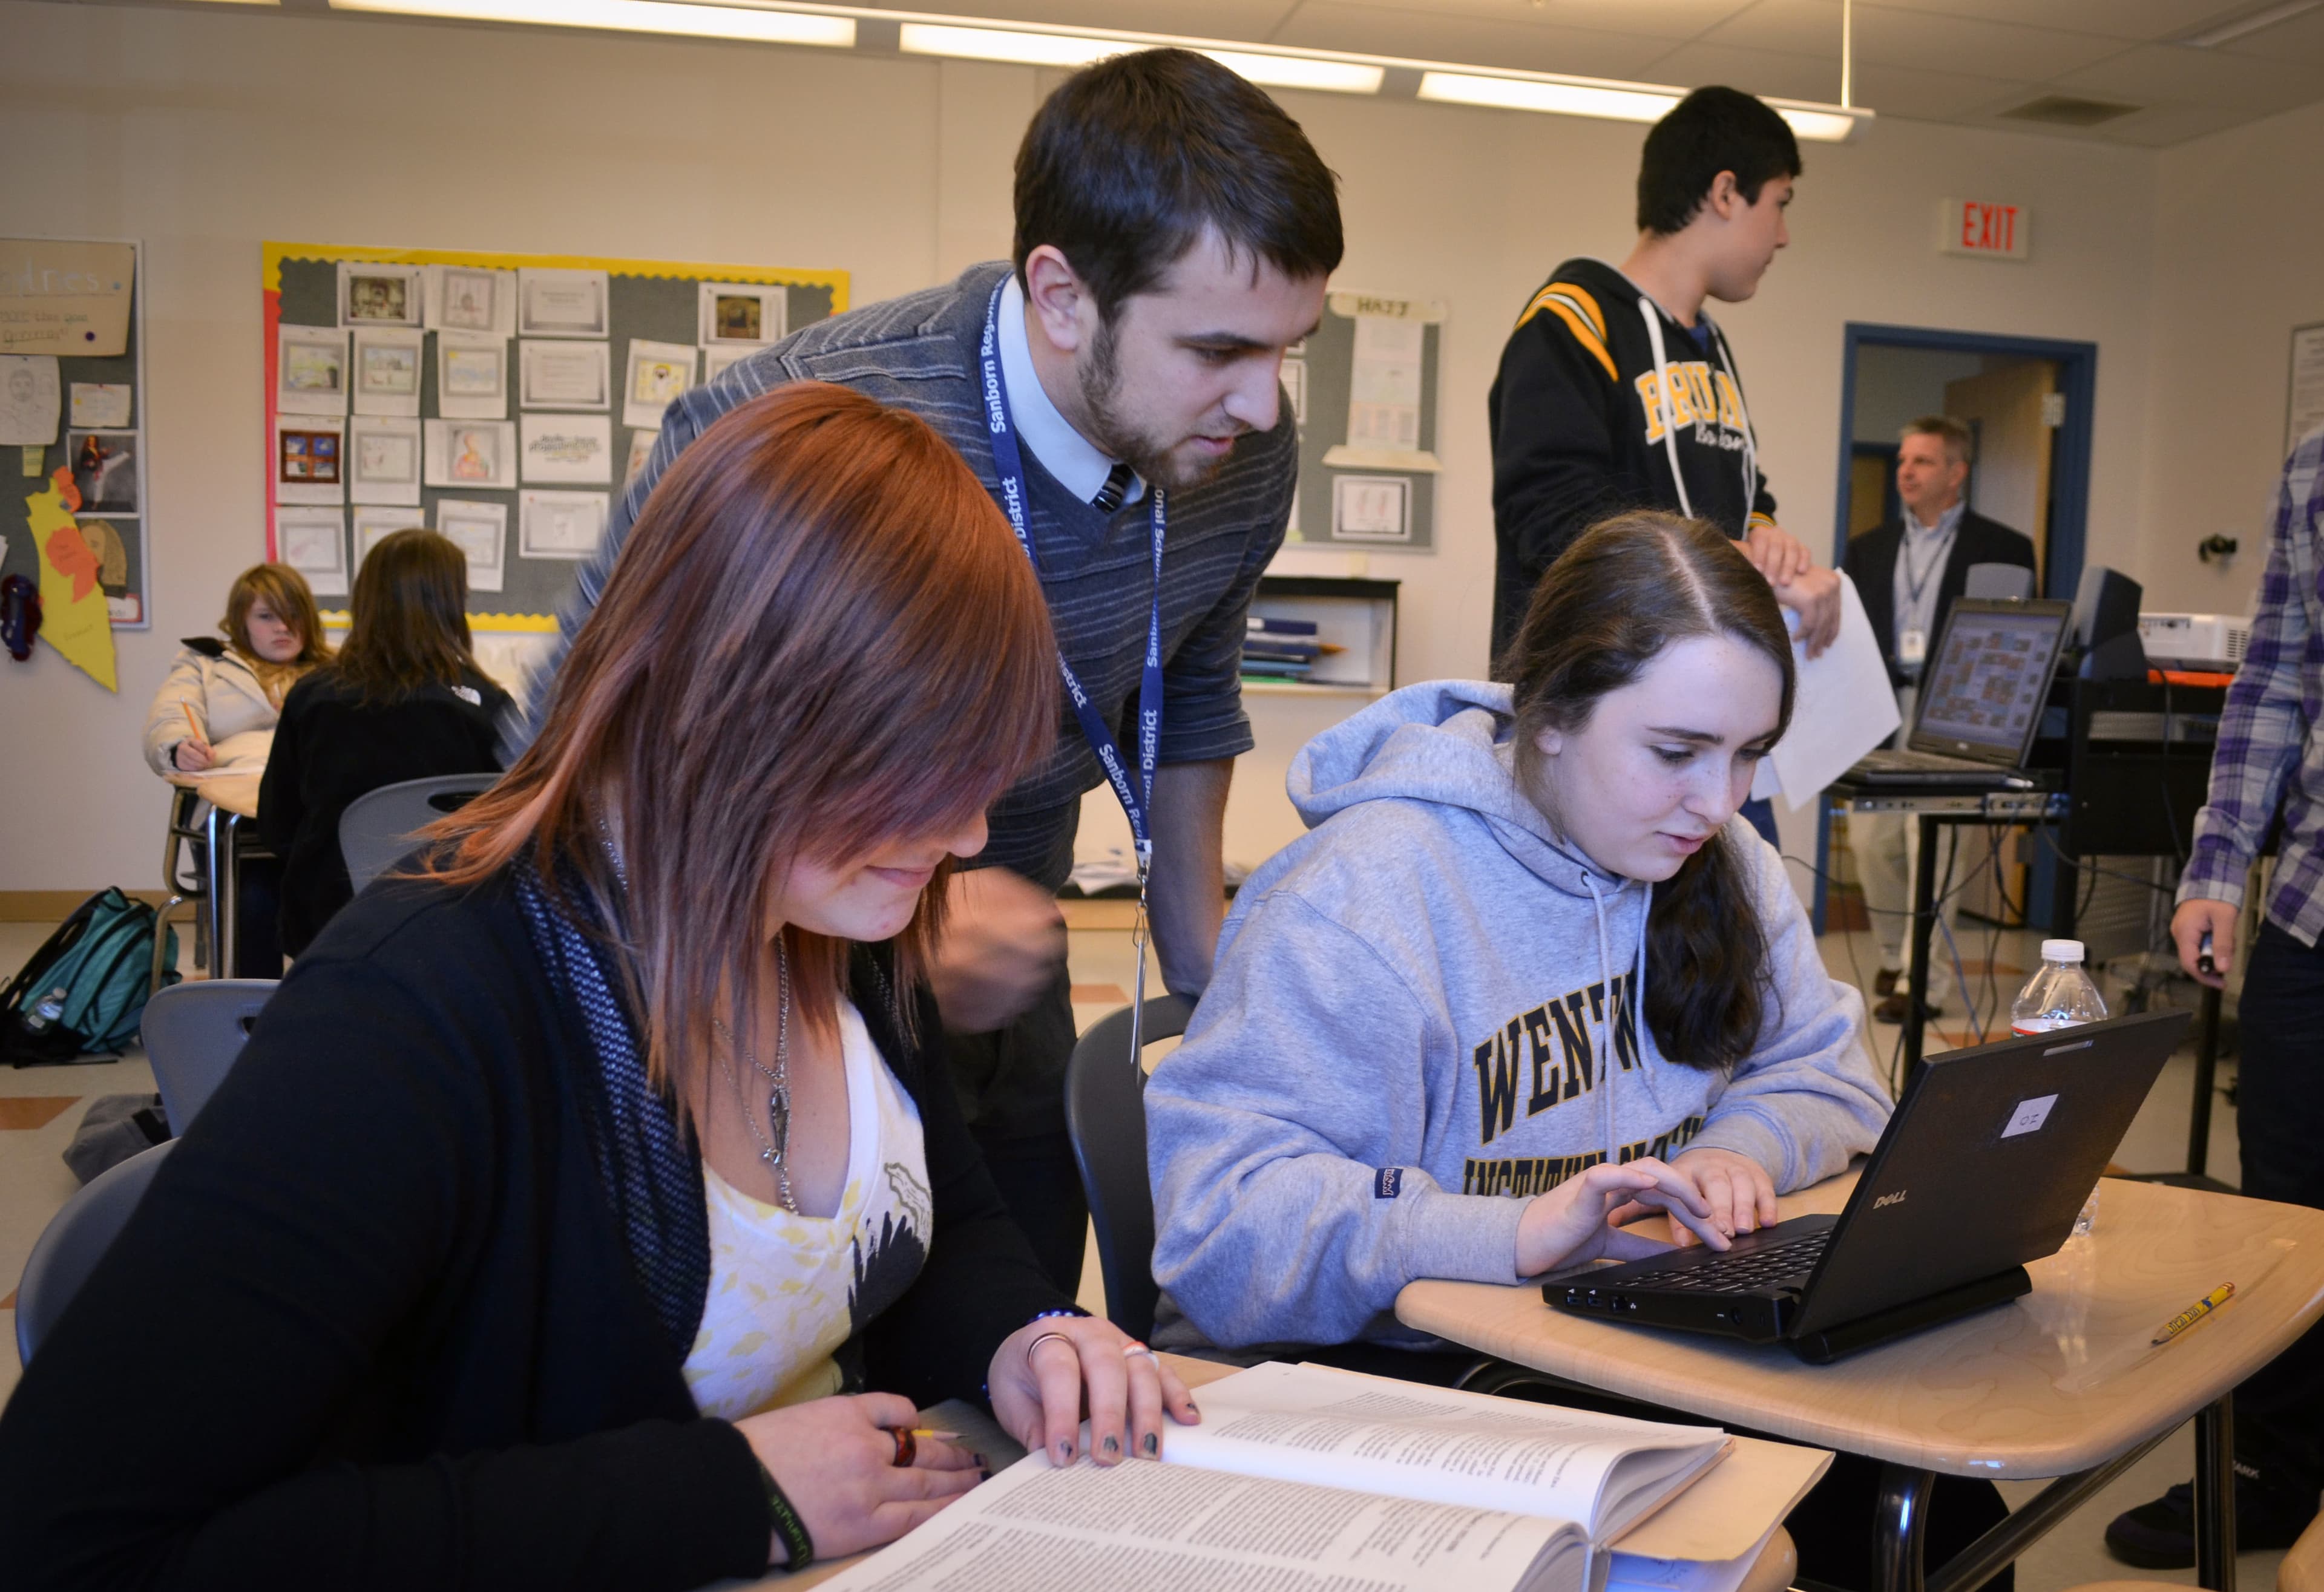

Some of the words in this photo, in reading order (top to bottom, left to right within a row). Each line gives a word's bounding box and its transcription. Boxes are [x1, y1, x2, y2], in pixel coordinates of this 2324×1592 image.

[1963, 201, 2018, 252] EXIT
[984, 360, 1006, 433] Sanborn
[1002, 476, 1026, 539] District
[1143, 710, 1157, 770] District
[1099, 743, 1134, 805] Sanborn
[1873, 1190, 1907, 1209] DELL
